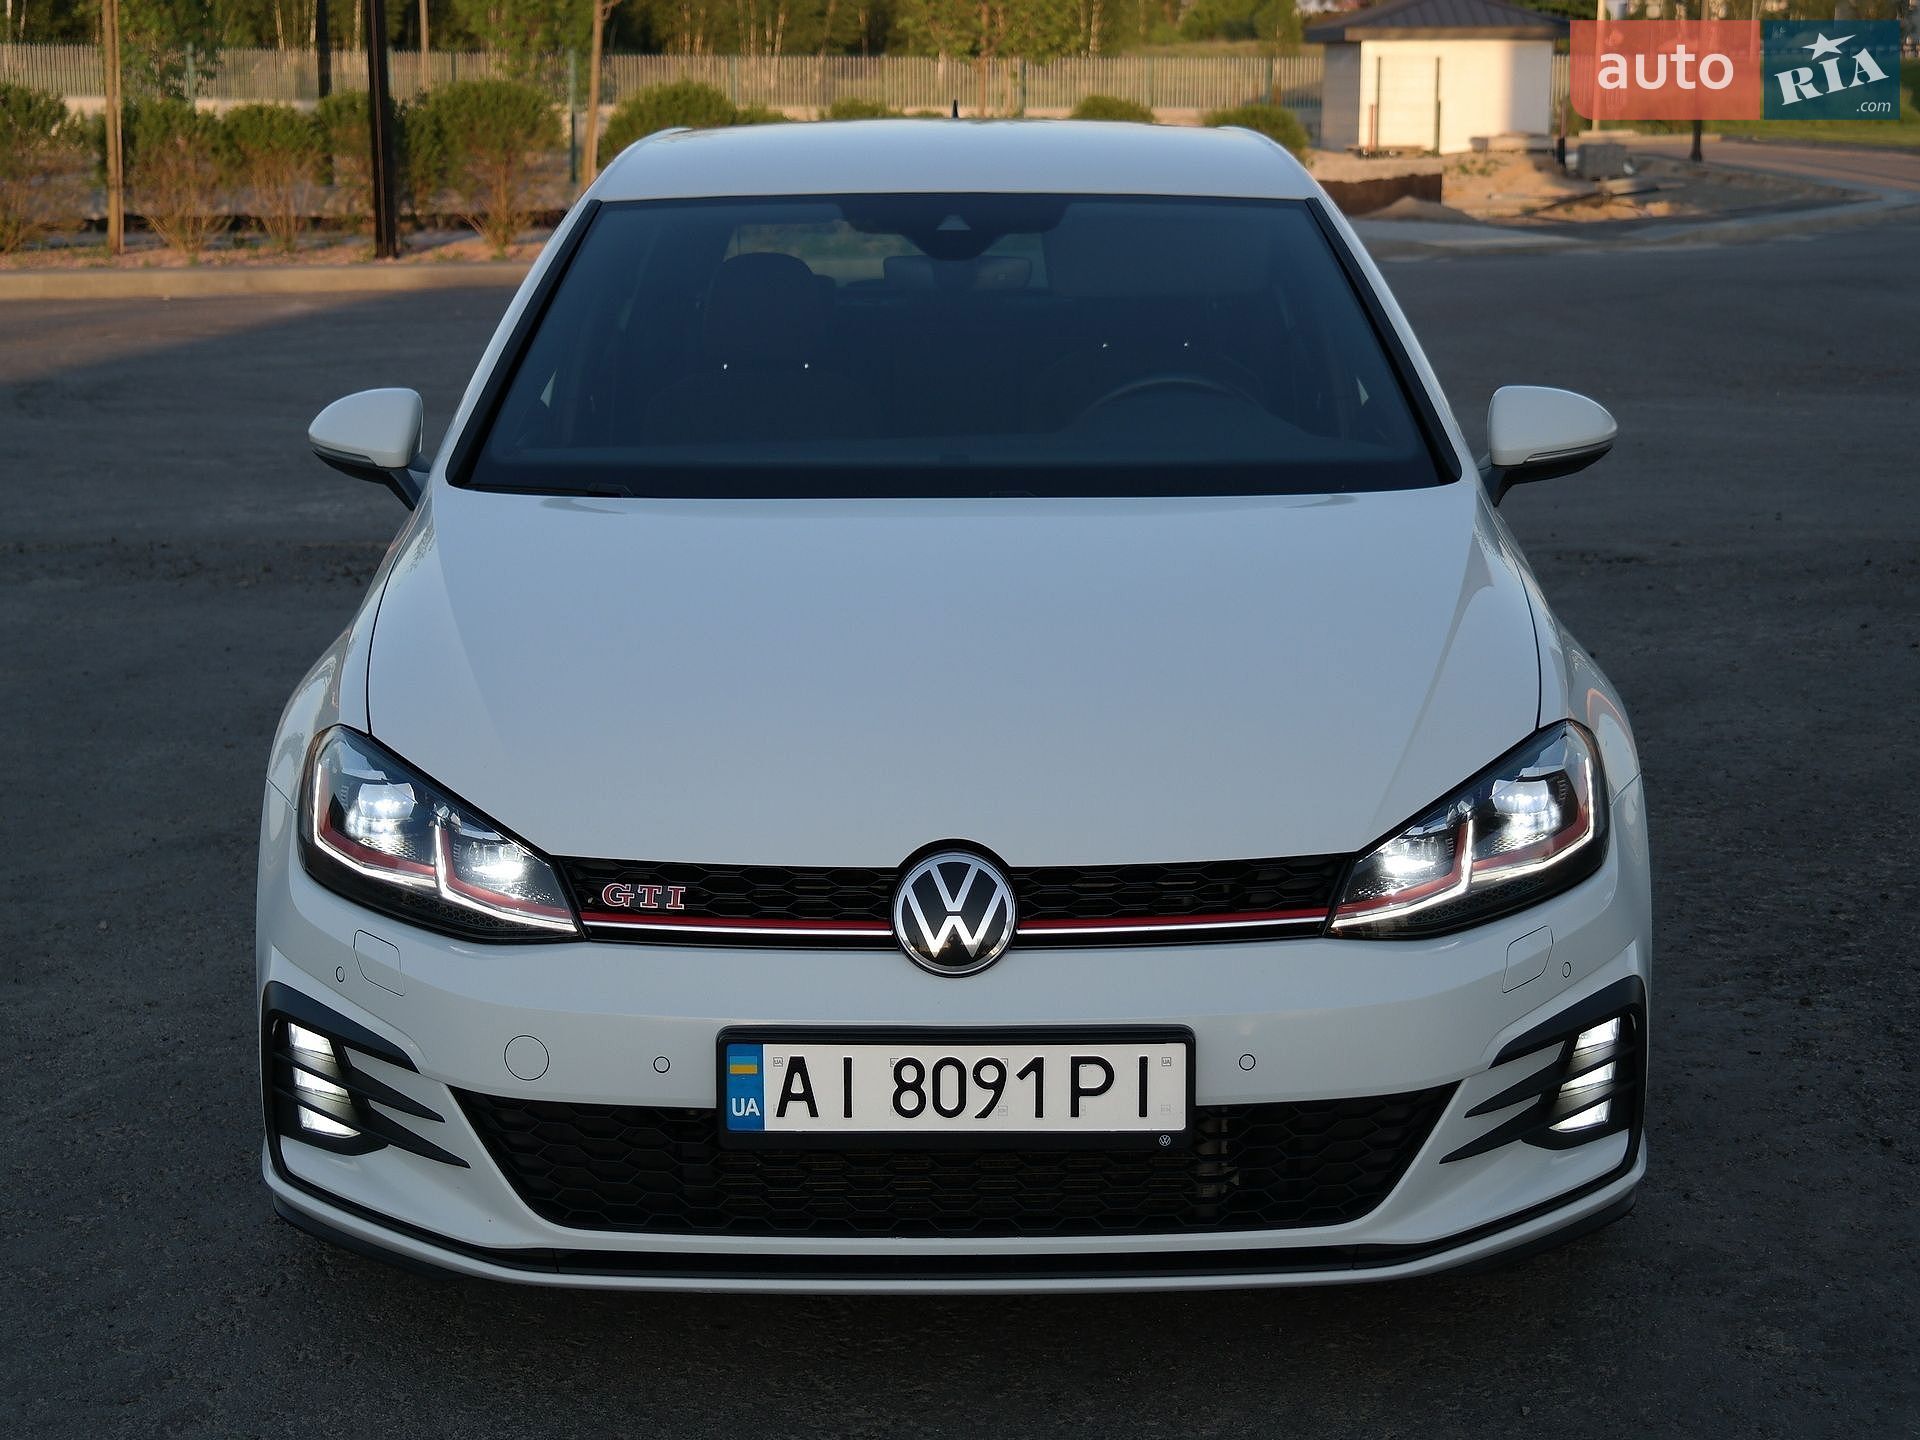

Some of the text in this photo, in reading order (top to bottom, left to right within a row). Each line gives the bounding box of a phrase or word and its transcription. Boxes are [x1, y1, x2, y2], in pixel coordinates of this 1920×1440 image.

[602, 883, 686, 910] GTI
[775, 1056, 1148, 1119] AI 8091 PI
[731, 1097, 760, 1117] UA
